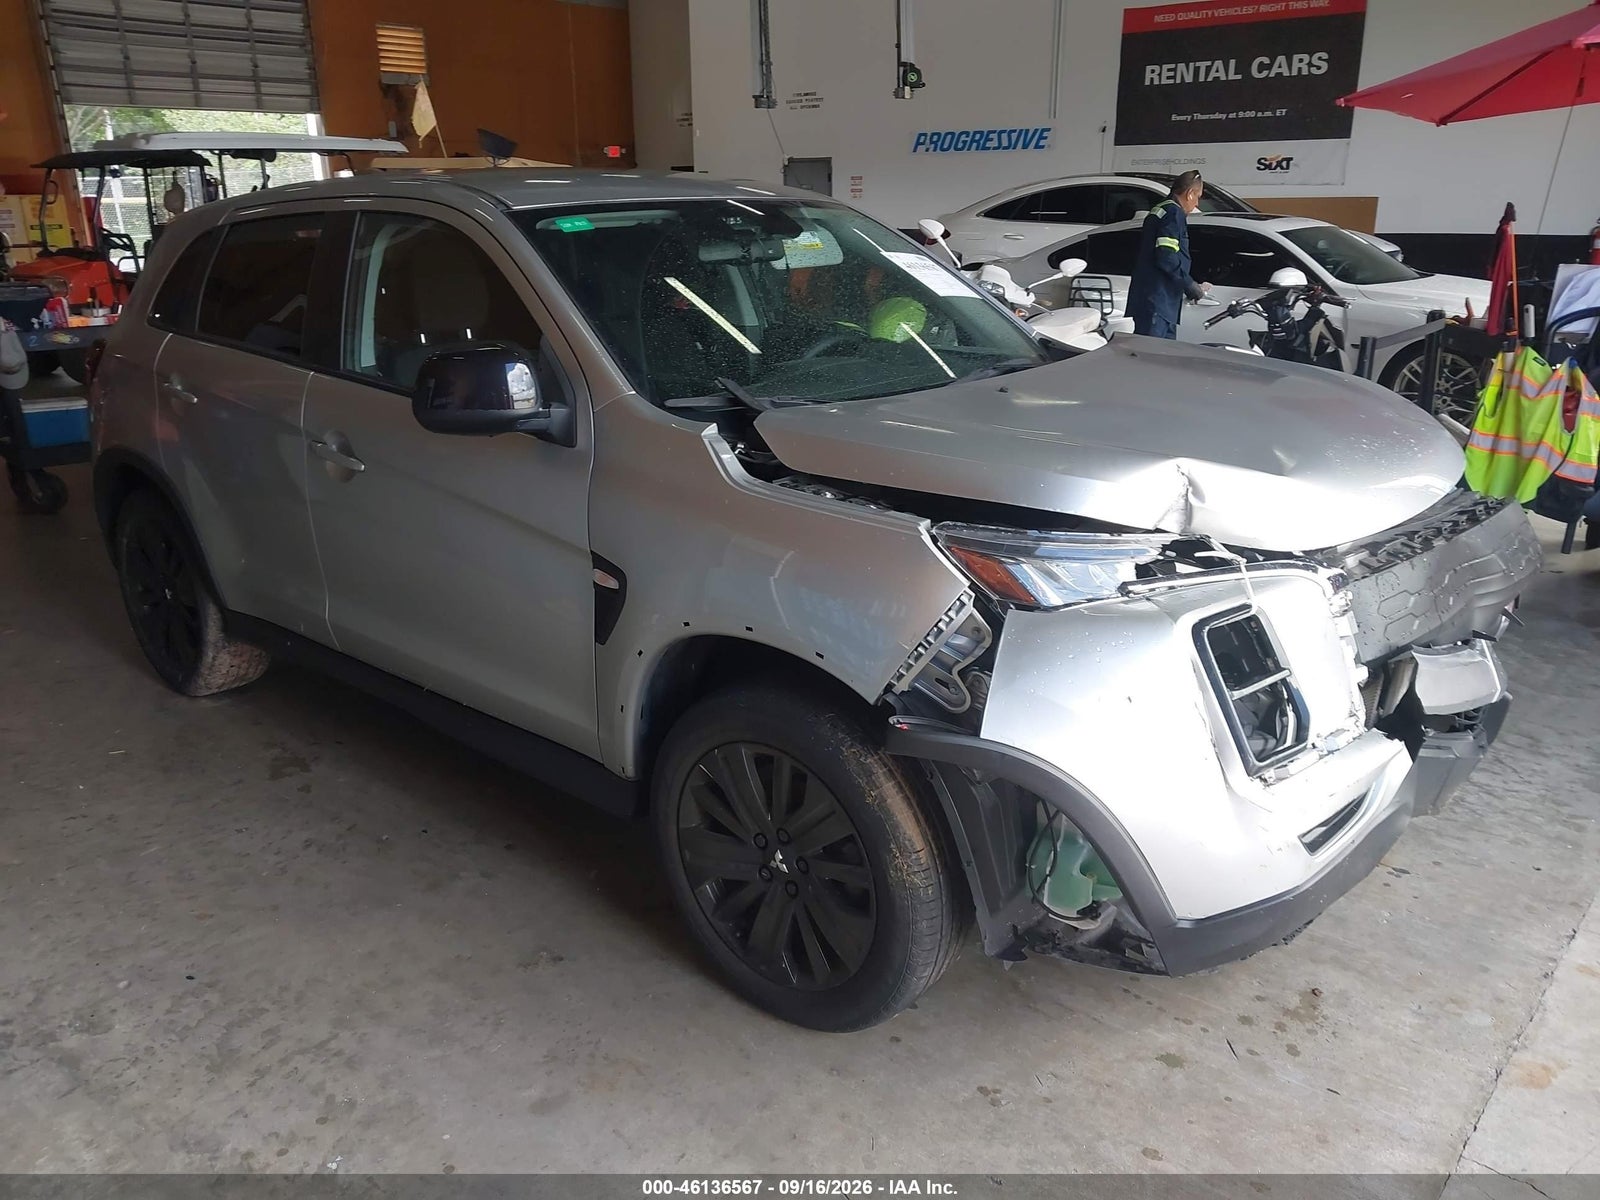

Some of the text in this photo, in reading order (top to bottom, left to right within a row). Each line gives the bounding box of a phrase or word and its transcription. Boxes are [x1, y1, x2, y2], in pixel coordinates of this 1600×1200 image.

[1154, 13, 1176, 23] NEED
[1177, 10, 1213, 20] QUALITY
[1214, 5, 1258, 16] VEHICLES?
[1259, 2, 1287, 12] RIGHT
[1288, 1, 1308, 10] THIS
[1144, 52, 1329, 86] RENTAL CARS
[1193, 112, 1227, 120] Thursday
[1238, 110, 1256, 118] 9:00
[1276, 108, 1288, 116] ET
[912, 128, 1052, 153] PROGRESSIVE
